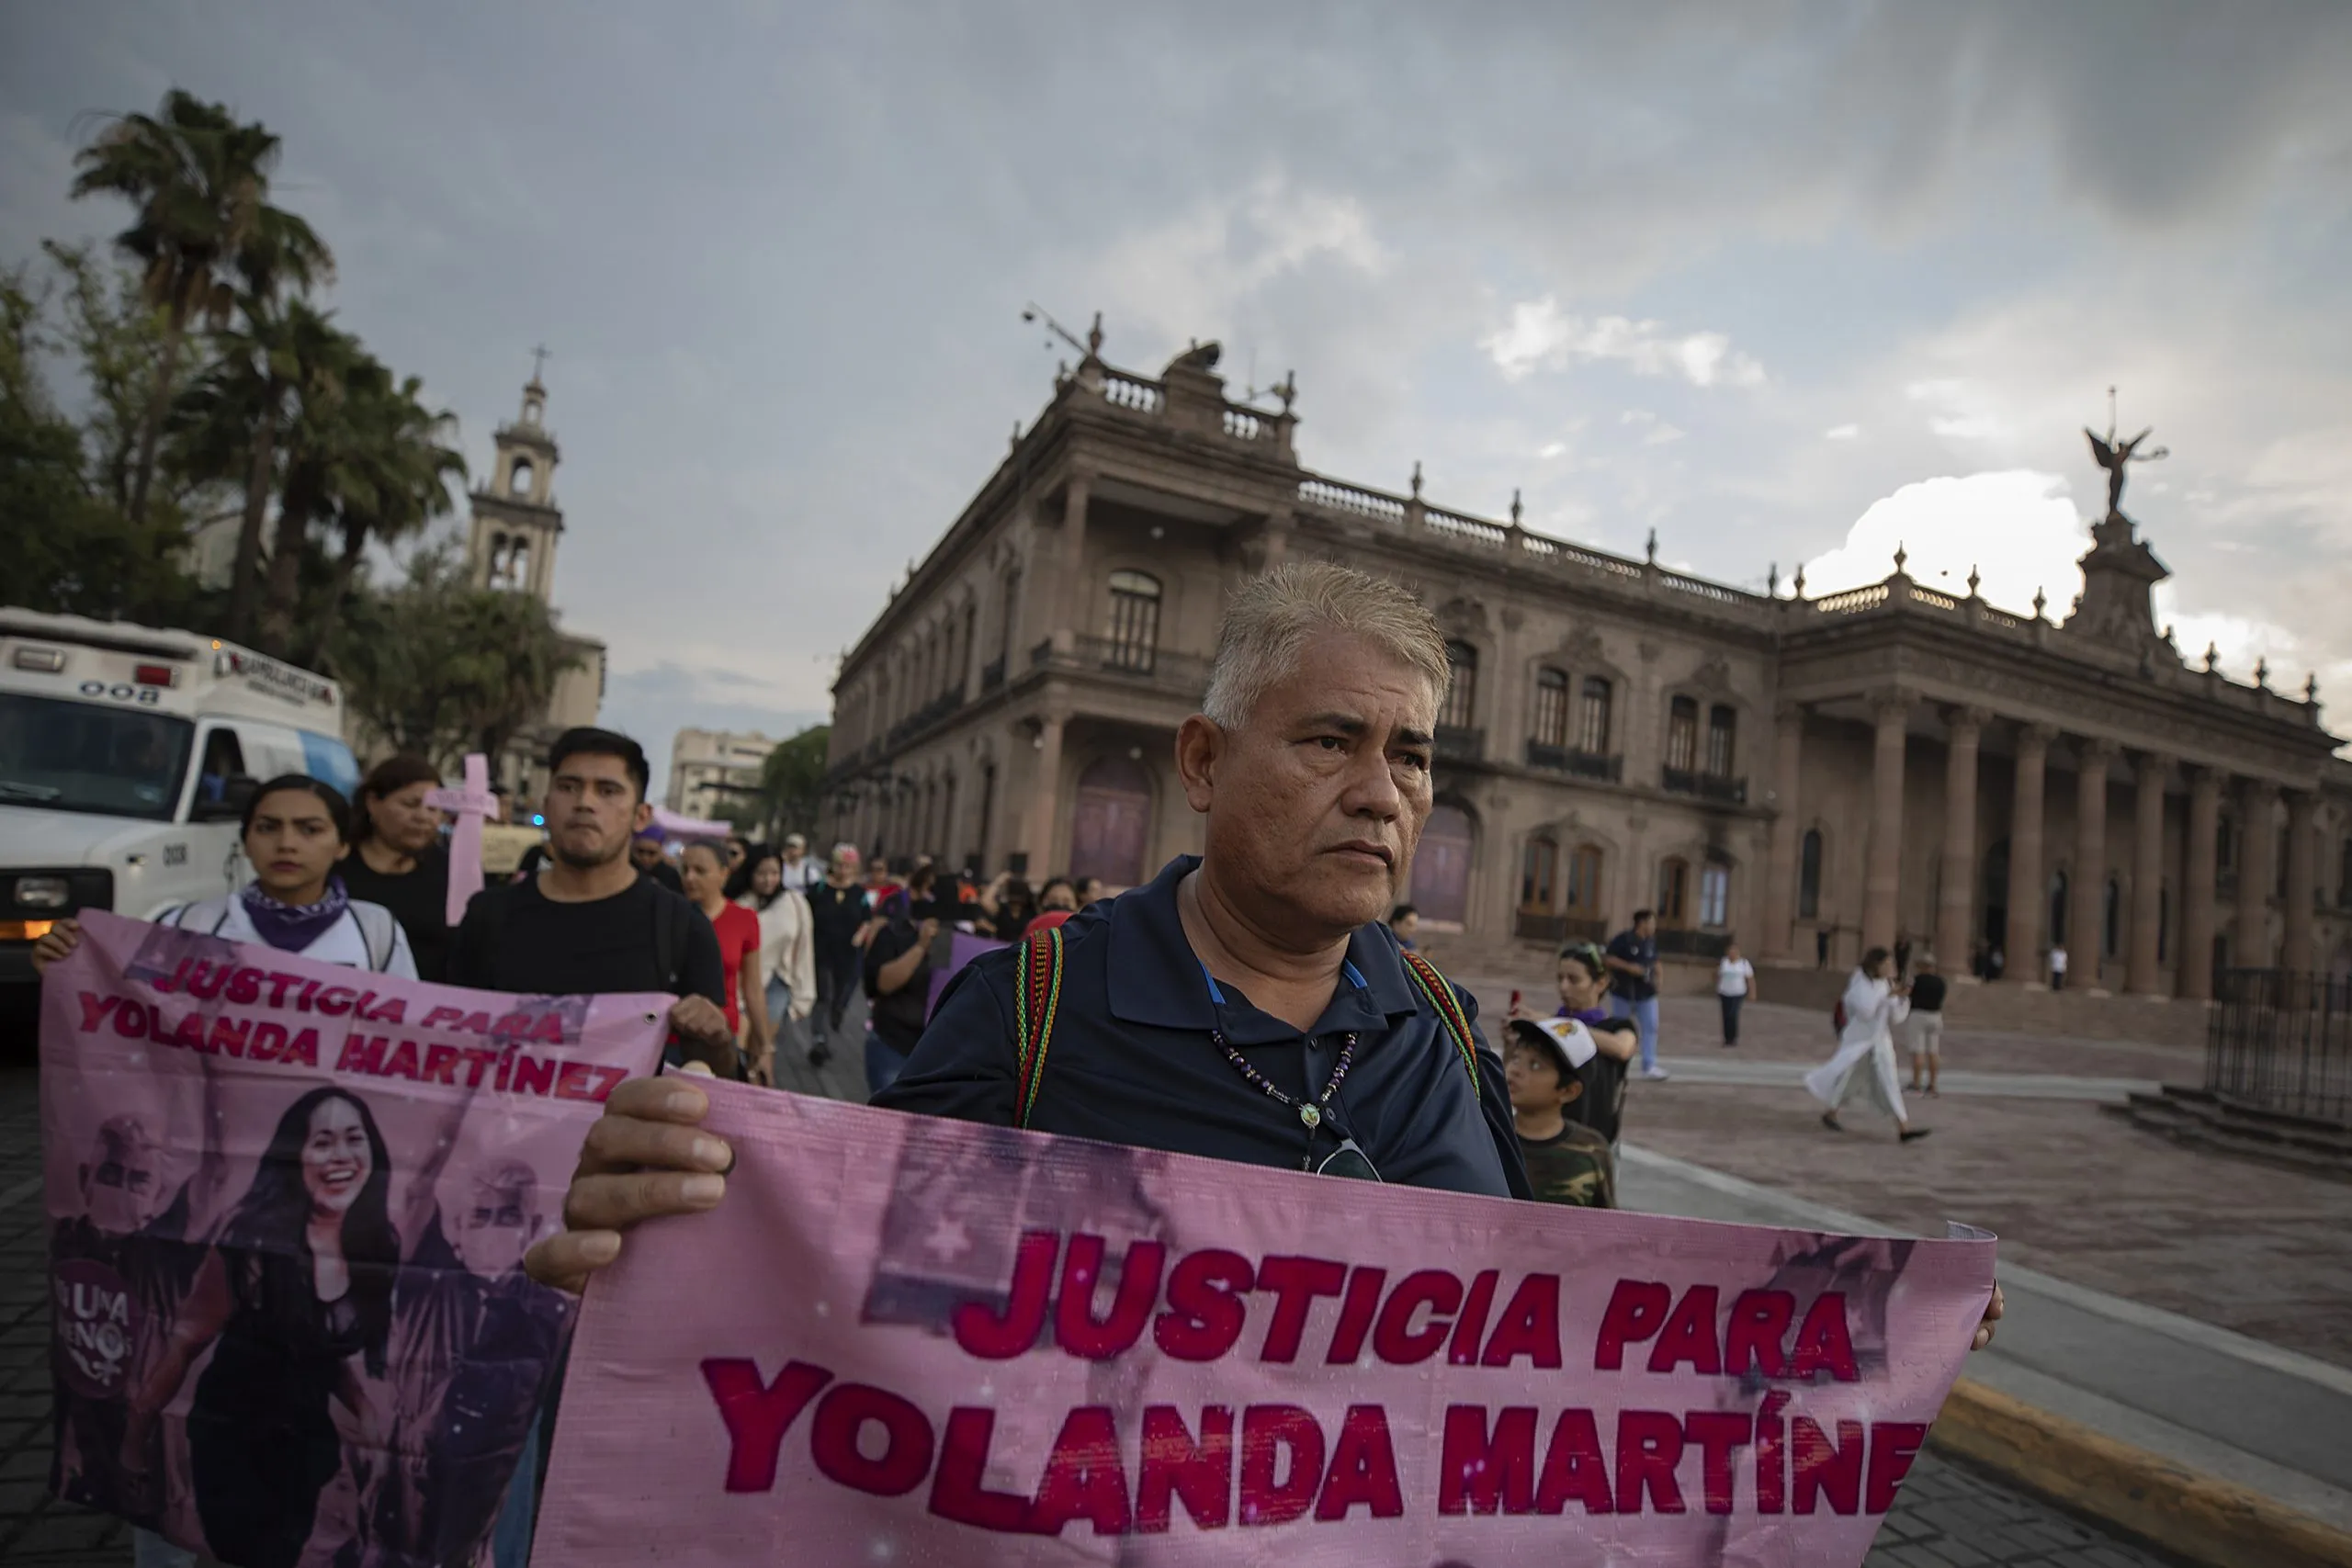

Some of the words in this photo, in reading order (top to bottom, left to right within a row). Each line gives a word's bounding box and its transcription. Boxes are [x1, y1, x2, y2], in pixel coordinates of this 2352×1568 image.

[78, 991, 319, 1066] YOLANDA
[335, 1033, 629, 1103] MARTÍNEZ
[152, 957, 407, 1024] JUSTICIA
[420, 1006, 564, 1044] PARA
[952, 1230, 1563, 1369] JUSTICIA
[1593, 1278, 1860, 1382] PARA
[700, 1356, 1403, 1537] YOLANDA
[1437, 1388, 1931, 1516] MARTÍNE
